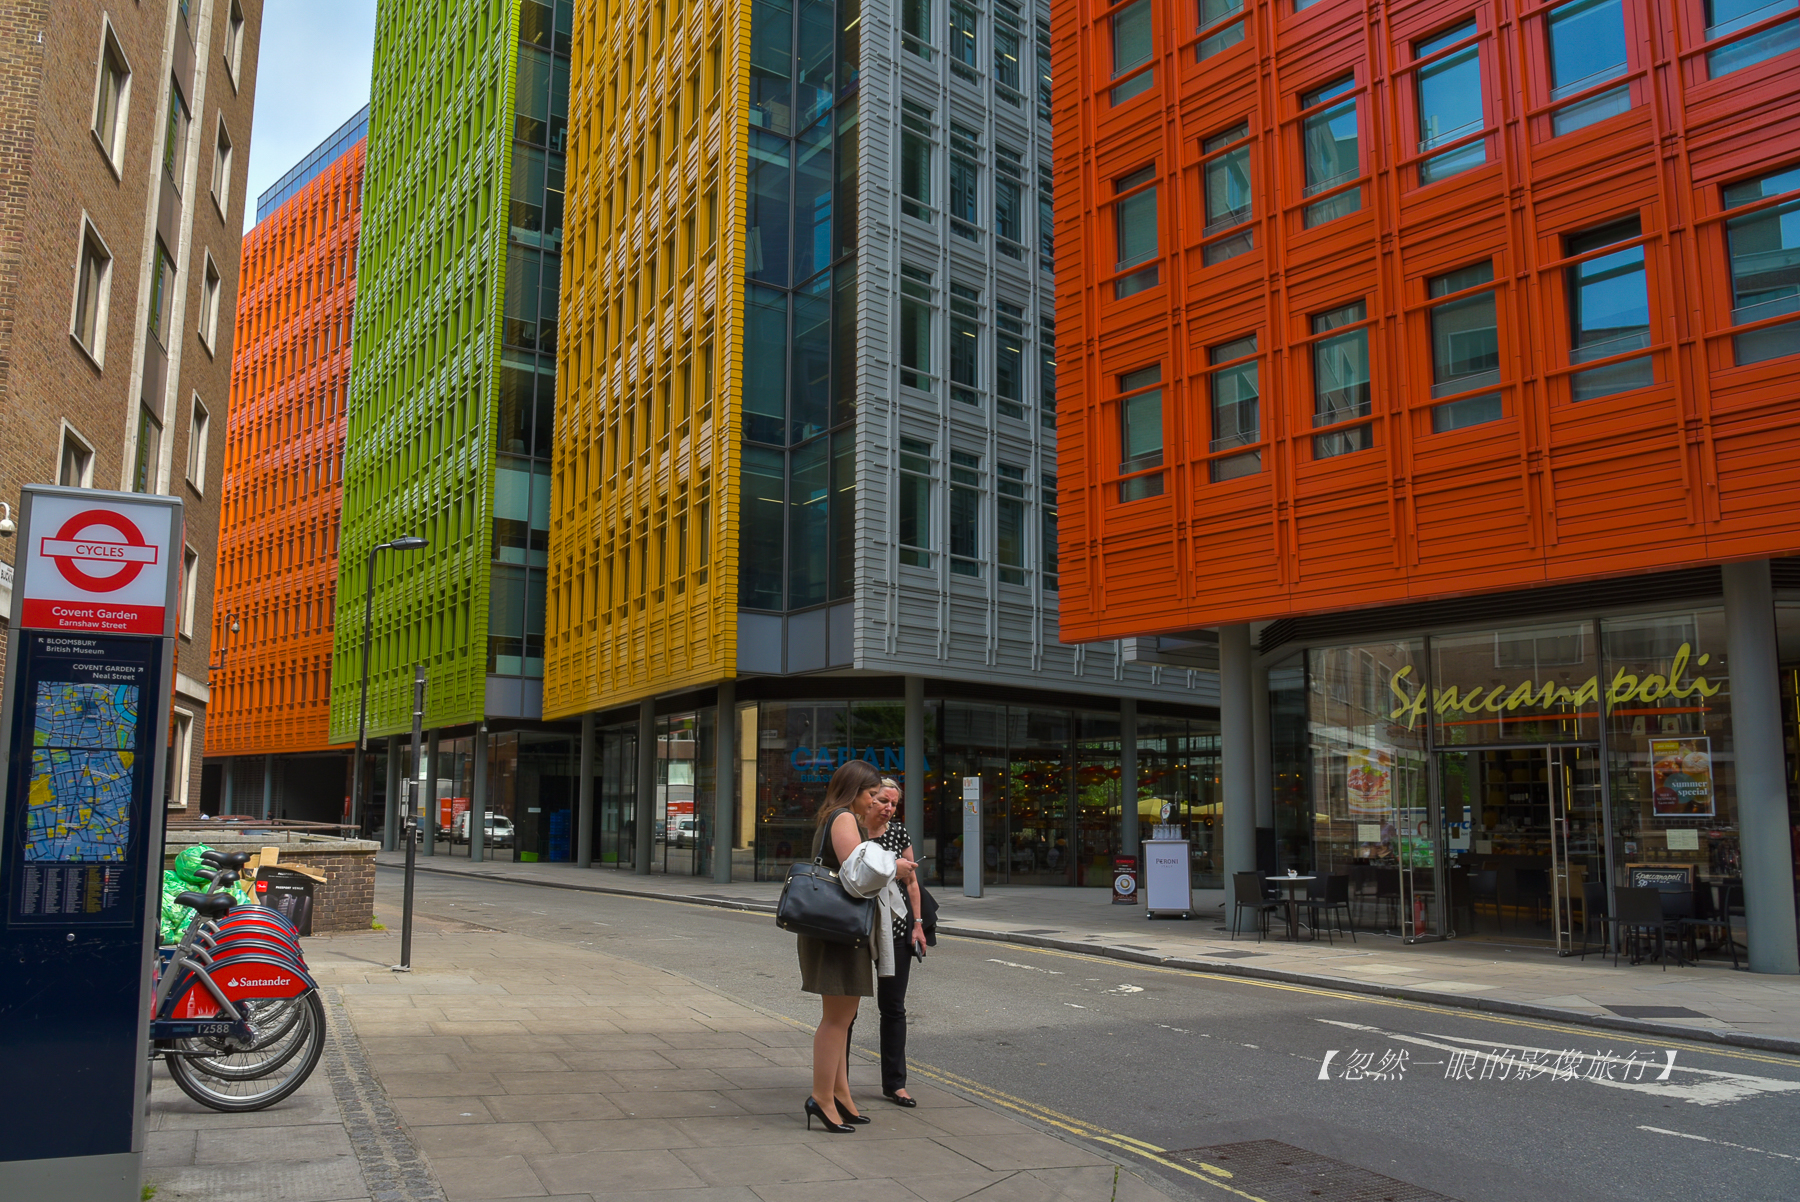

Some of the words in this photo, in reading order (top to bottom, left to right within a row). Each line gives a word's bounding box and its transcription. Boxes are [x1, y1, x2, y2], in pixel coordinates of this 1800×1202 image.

[75, 544, 124, 557] CYCLES
[52, 606, 94, 618] Covent
[97, 609, 138, 620] Garden
[59, 619, 100, 628] Earnshaw
[101, 621, 127, 630] Street
[46, 637, 97, 646] BLOOMSBURY
[46, 645, 71, 653] British
[72, 647, 104, 655] Museum
[72, 663, 103, 672] COVENT
[105, 665, 136, 673] GARDEN
[92, 672, 111, 680] Neal
[112, 673, 135, 681] Street
[1390, 642, 1721, 732] Spaccanapoli
[1677, 788, 1708, 797] special
[240, 976, 291, 987] Santander
